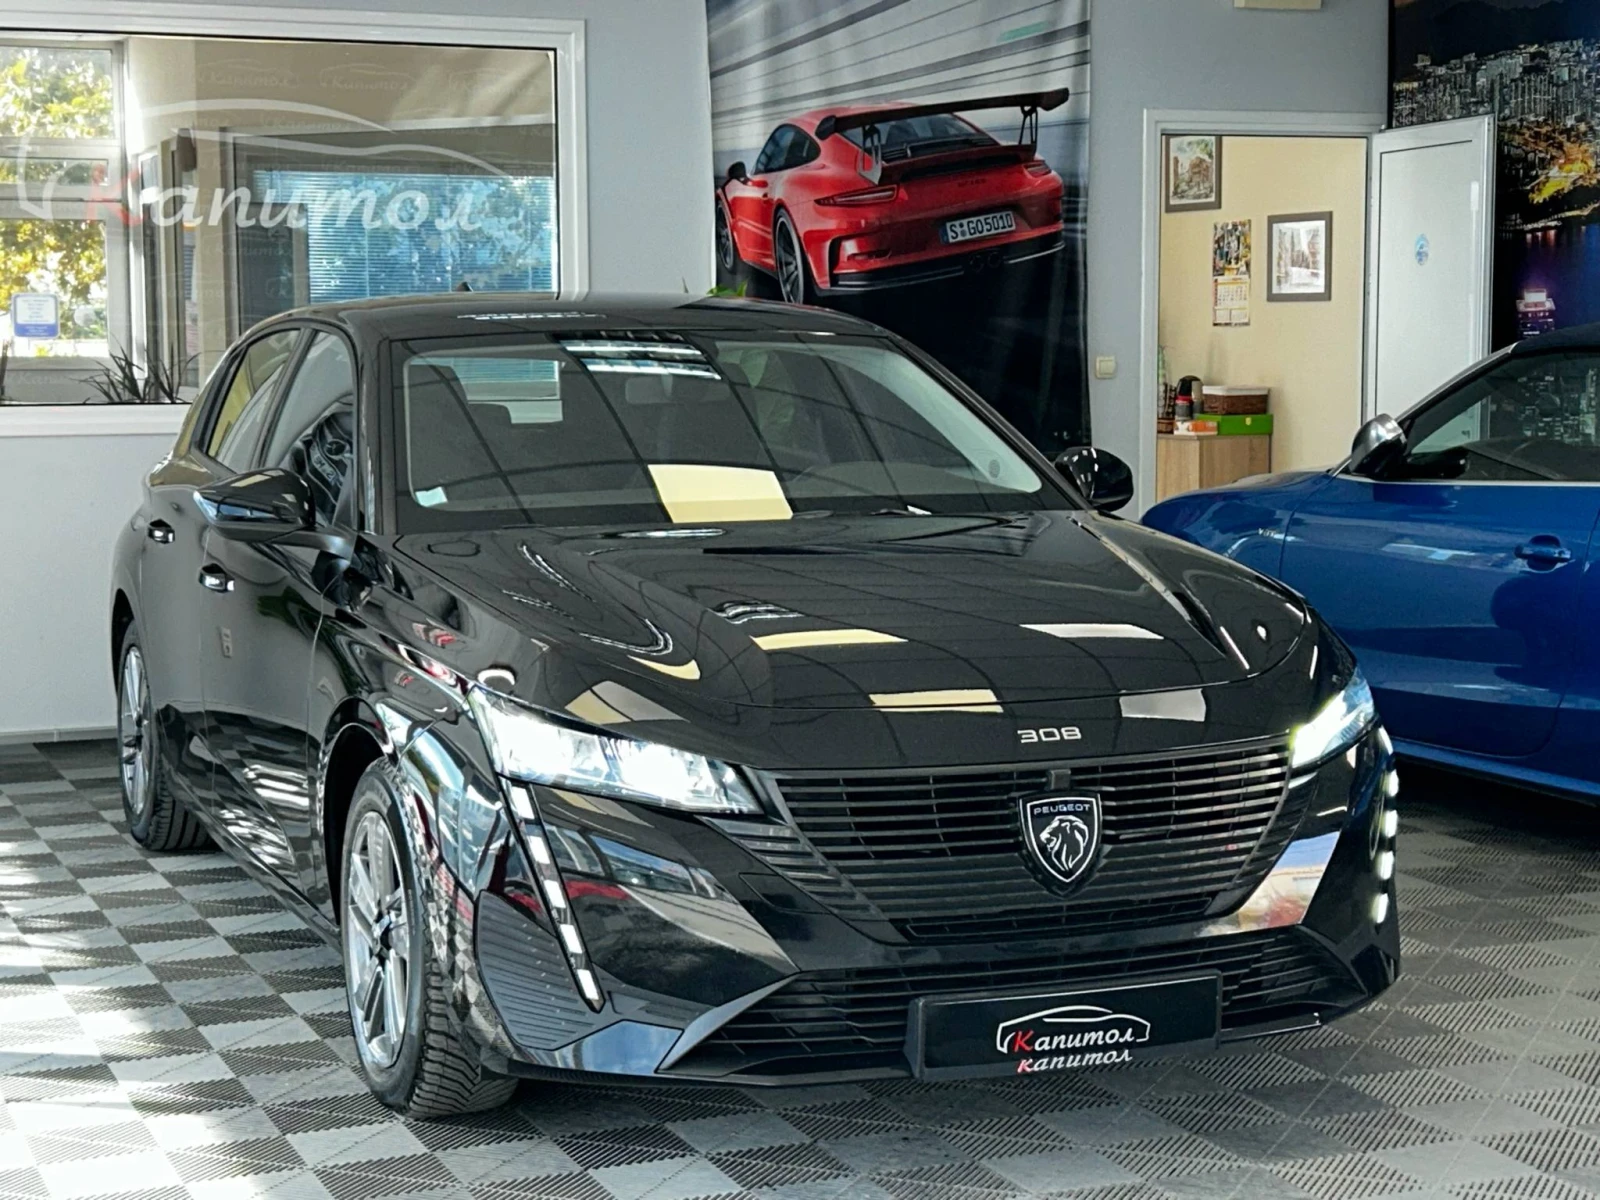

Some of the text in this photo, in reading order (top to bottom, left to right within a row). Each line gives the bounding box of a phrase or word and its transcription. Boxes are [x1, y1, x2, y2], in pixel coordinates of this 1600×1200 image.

[83, 163, 482, 231] Капитол
[1017, 726, 1082, 743] 308
[1033, 803, 1091, 816] PEUGEOT
[1013, 1027, 1135, 1052] Капитол
